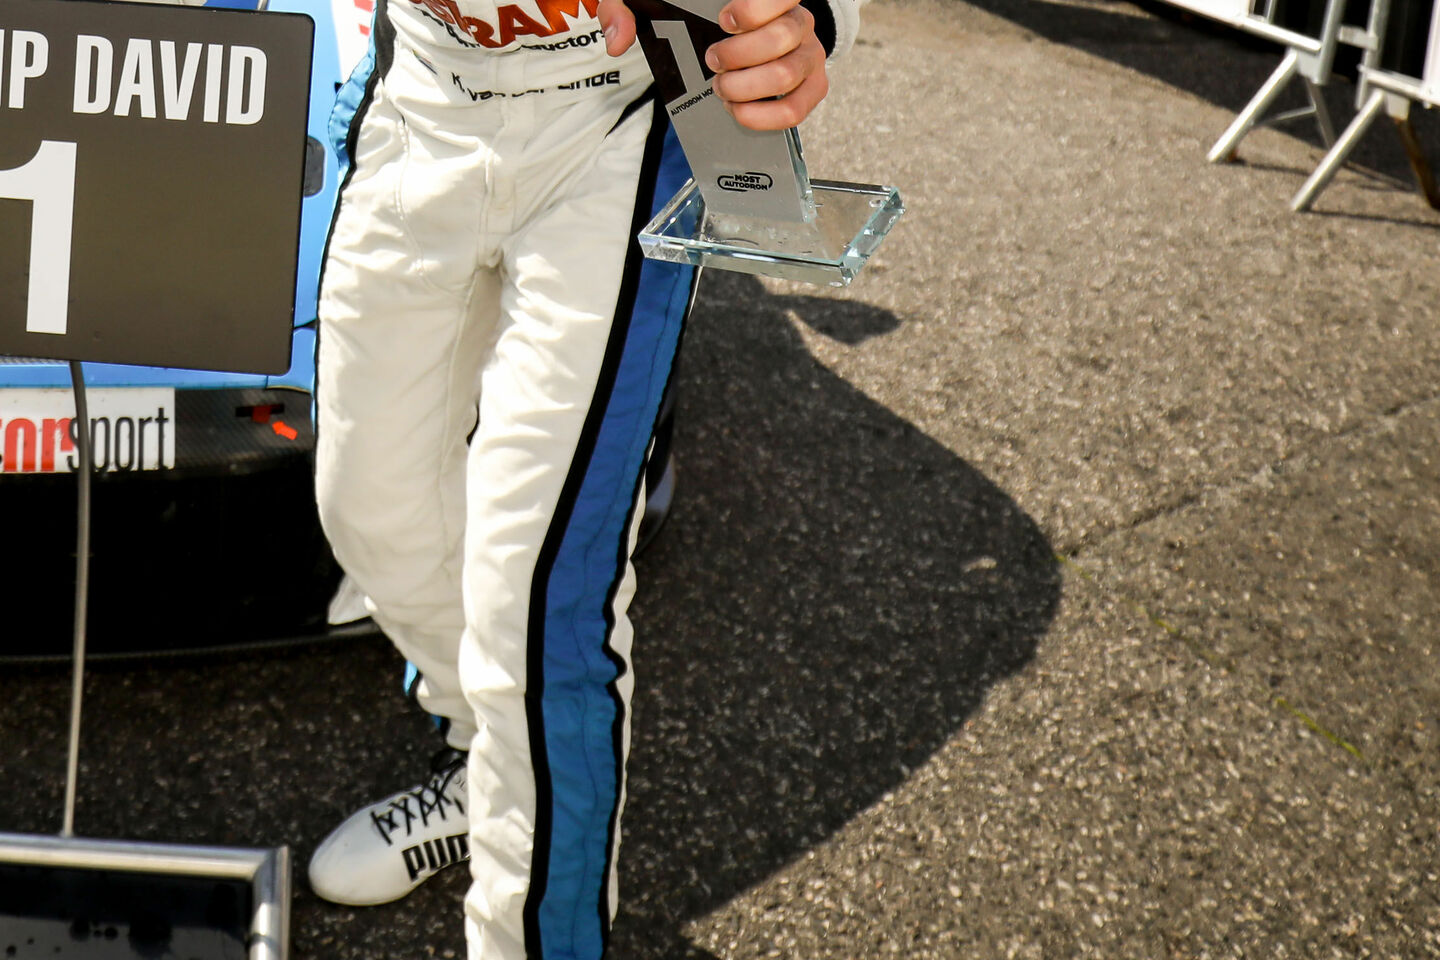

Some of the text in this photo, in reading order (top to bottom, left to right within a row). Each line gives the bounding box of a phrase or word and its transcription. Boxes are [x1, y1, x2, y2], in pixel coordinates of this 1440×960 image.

[650, 20, 706, 93] 1
[72, 34, 267, 126] DAVID
[671, 95, 703, 117] AUTODROM
[724, 180, 768, 190] AUTODROM
[734, 174, 761, 184] MOST
